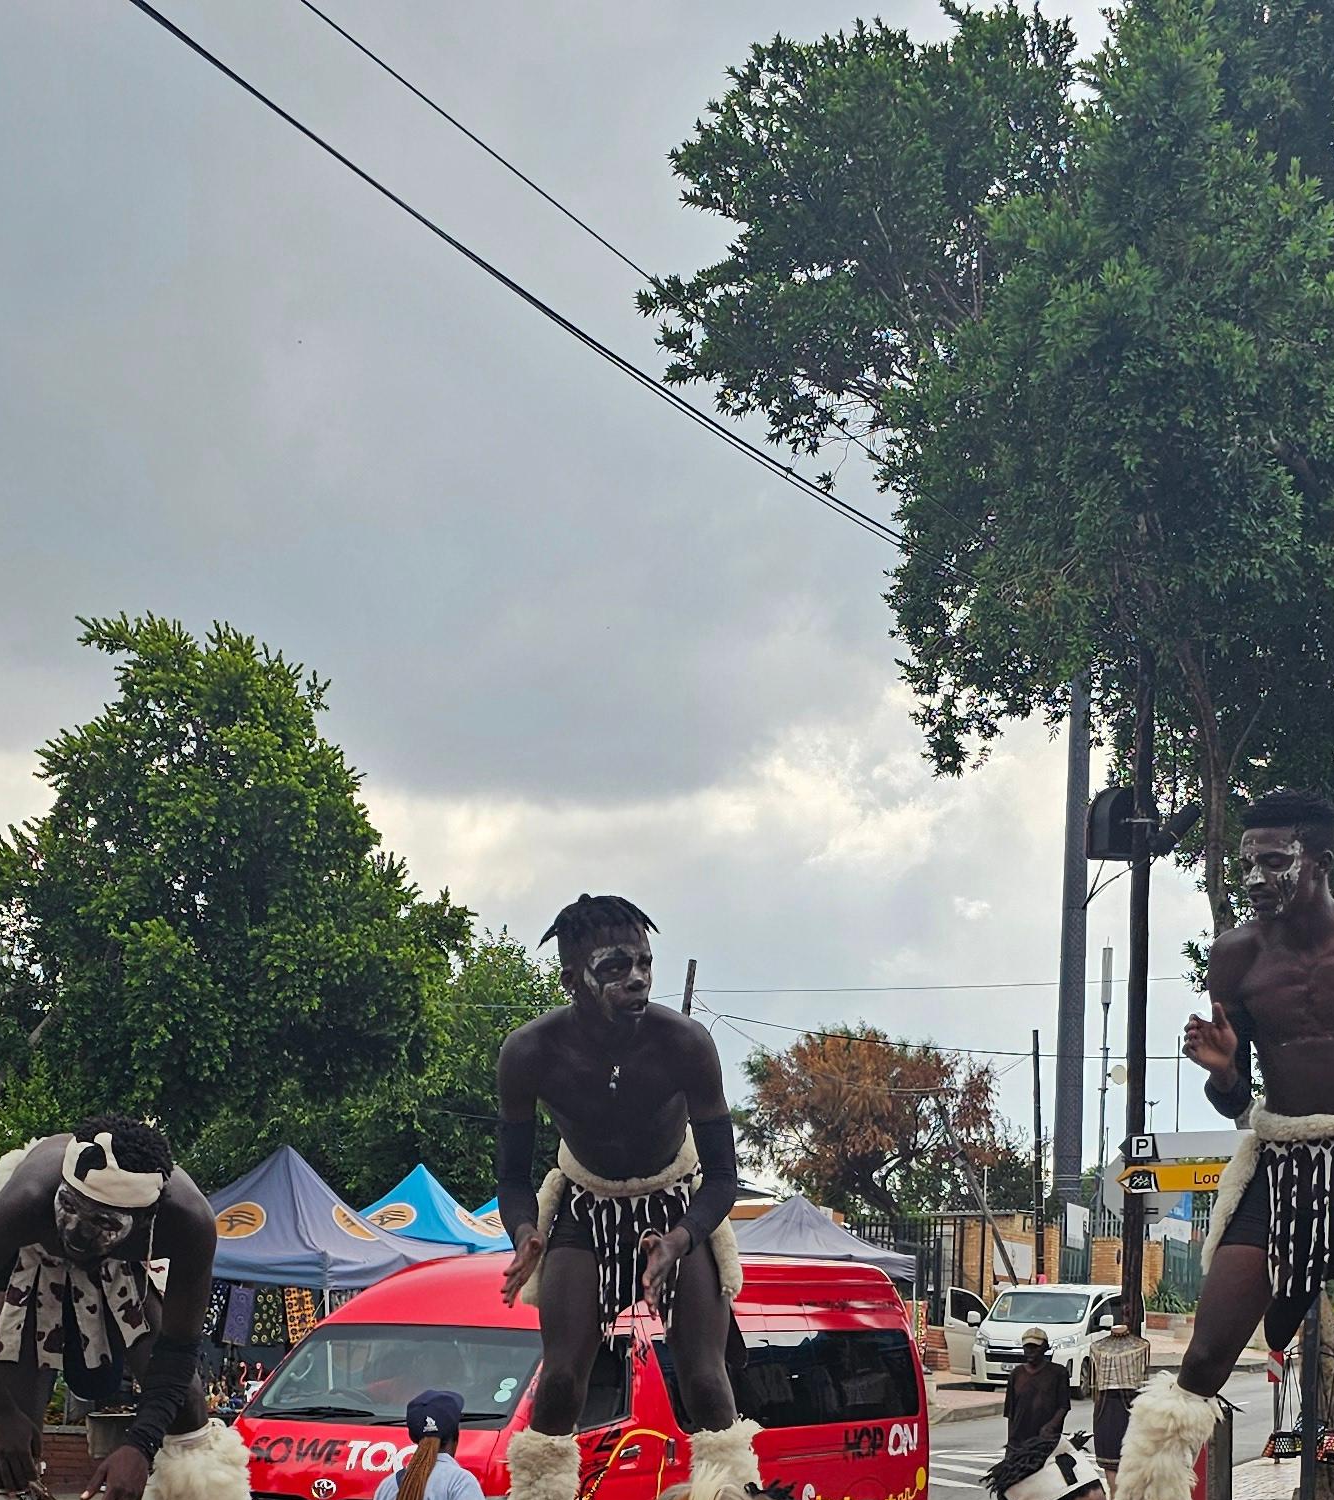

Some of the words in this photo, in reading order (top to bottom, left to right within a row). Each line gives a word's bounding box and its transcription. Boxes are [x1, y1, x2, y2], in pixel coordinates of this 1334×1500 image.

[1135, 1138, 1149, 1156] P
[1194, 1171, 1220, 1185] Loo
[843, 1426, 885, 1459] HOP
[888, 1423, 918, 1456] ON
